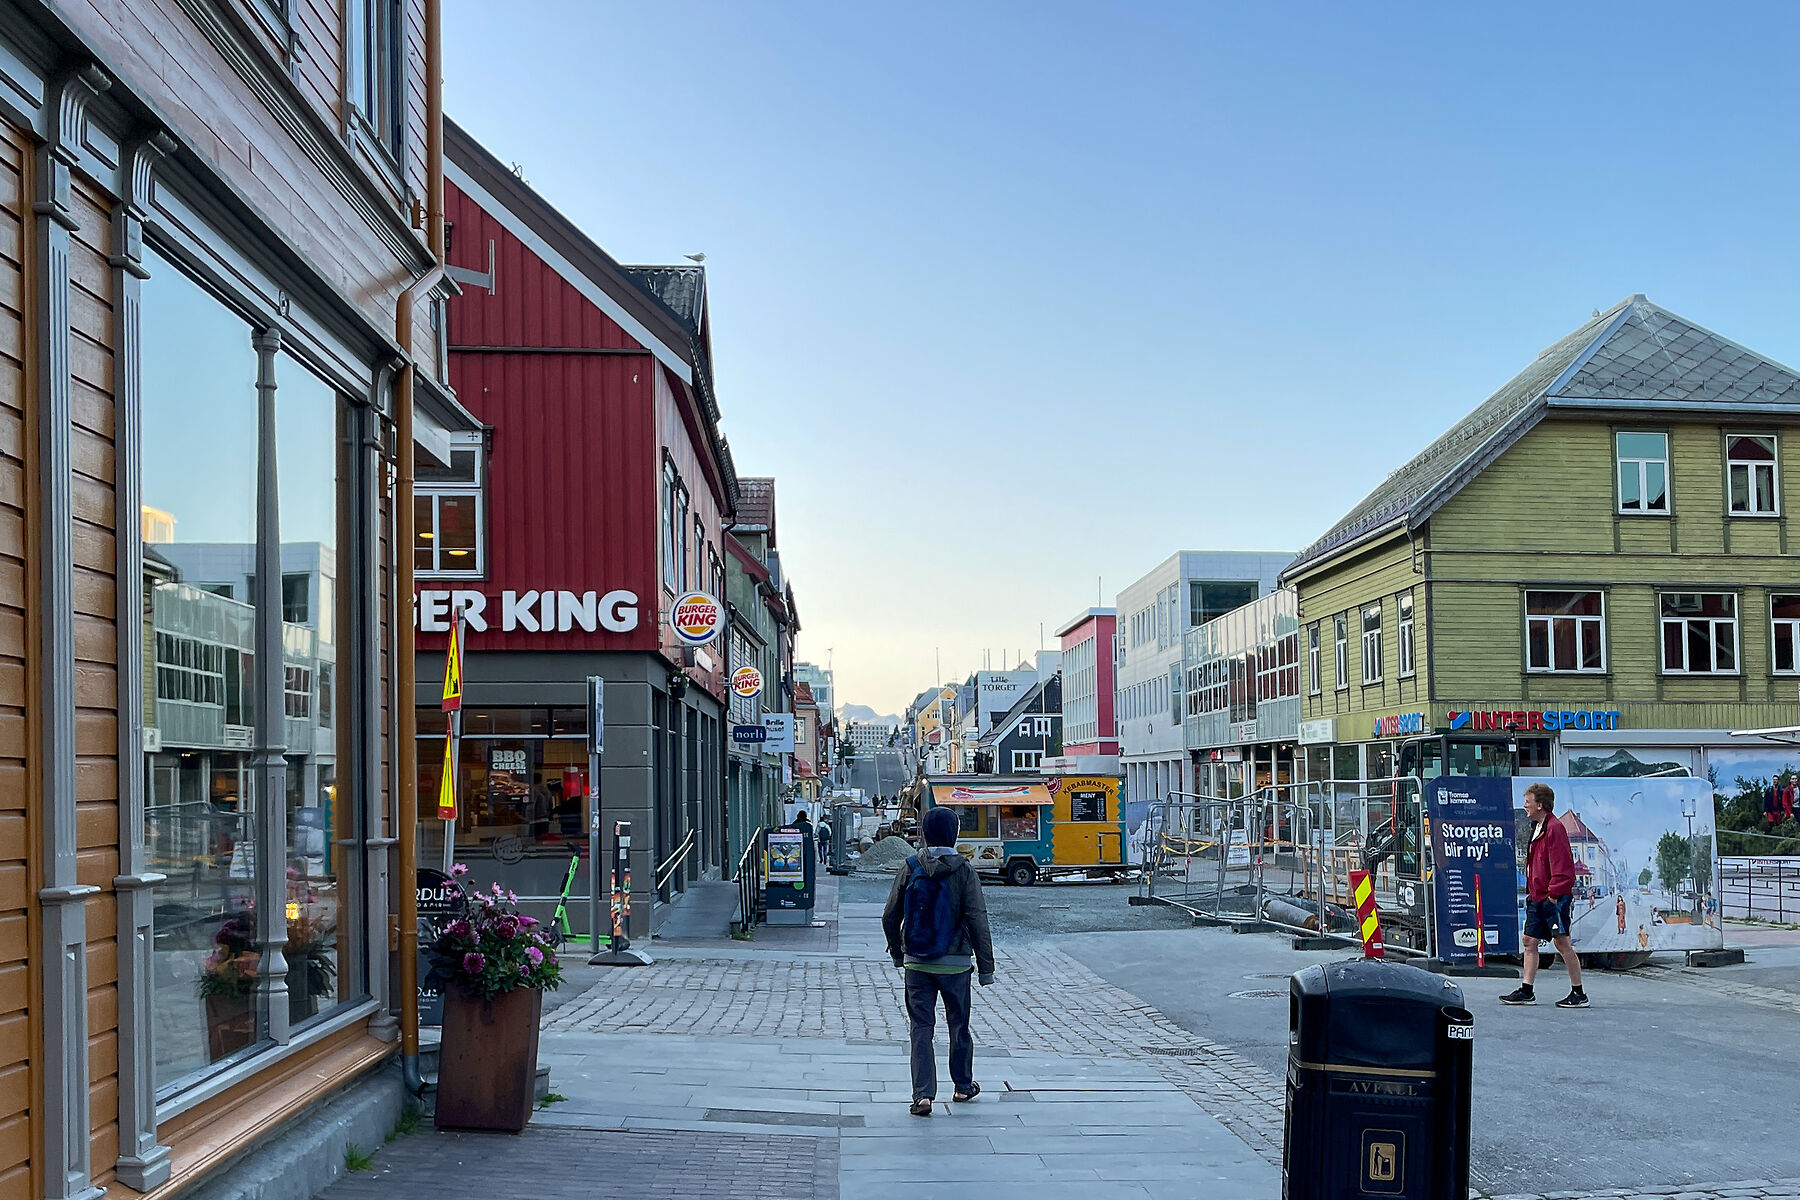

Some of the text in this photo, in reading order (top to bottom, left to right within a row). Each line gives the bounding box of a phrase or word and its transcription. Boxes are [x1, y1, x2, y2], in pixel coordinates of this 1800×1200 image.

[413, 590, 639, 632] ER KING
[678, 604, 717, 615] BURGER
[677, 613, 717, 627] KING
[734, 672, 759, 682] BURGER
[734, 679, 760, 690] KING
[1380, 712, 1421, 735] INTERSPORT
[1472, 710, 1621, 731] INTERSPORT
[736, 729, 763, 739] norli
[492, 750, 526, 763] BBQ
[492, 762, 526, 770] CHEESE
[1062, 780, 1115, 796] KEBABMASTER
[1441, 823, 1503, 841] Storgata
[1444, 841, 1489, 861] blir ny!
[1349, 1081, 1418, 1097] AVFALL
